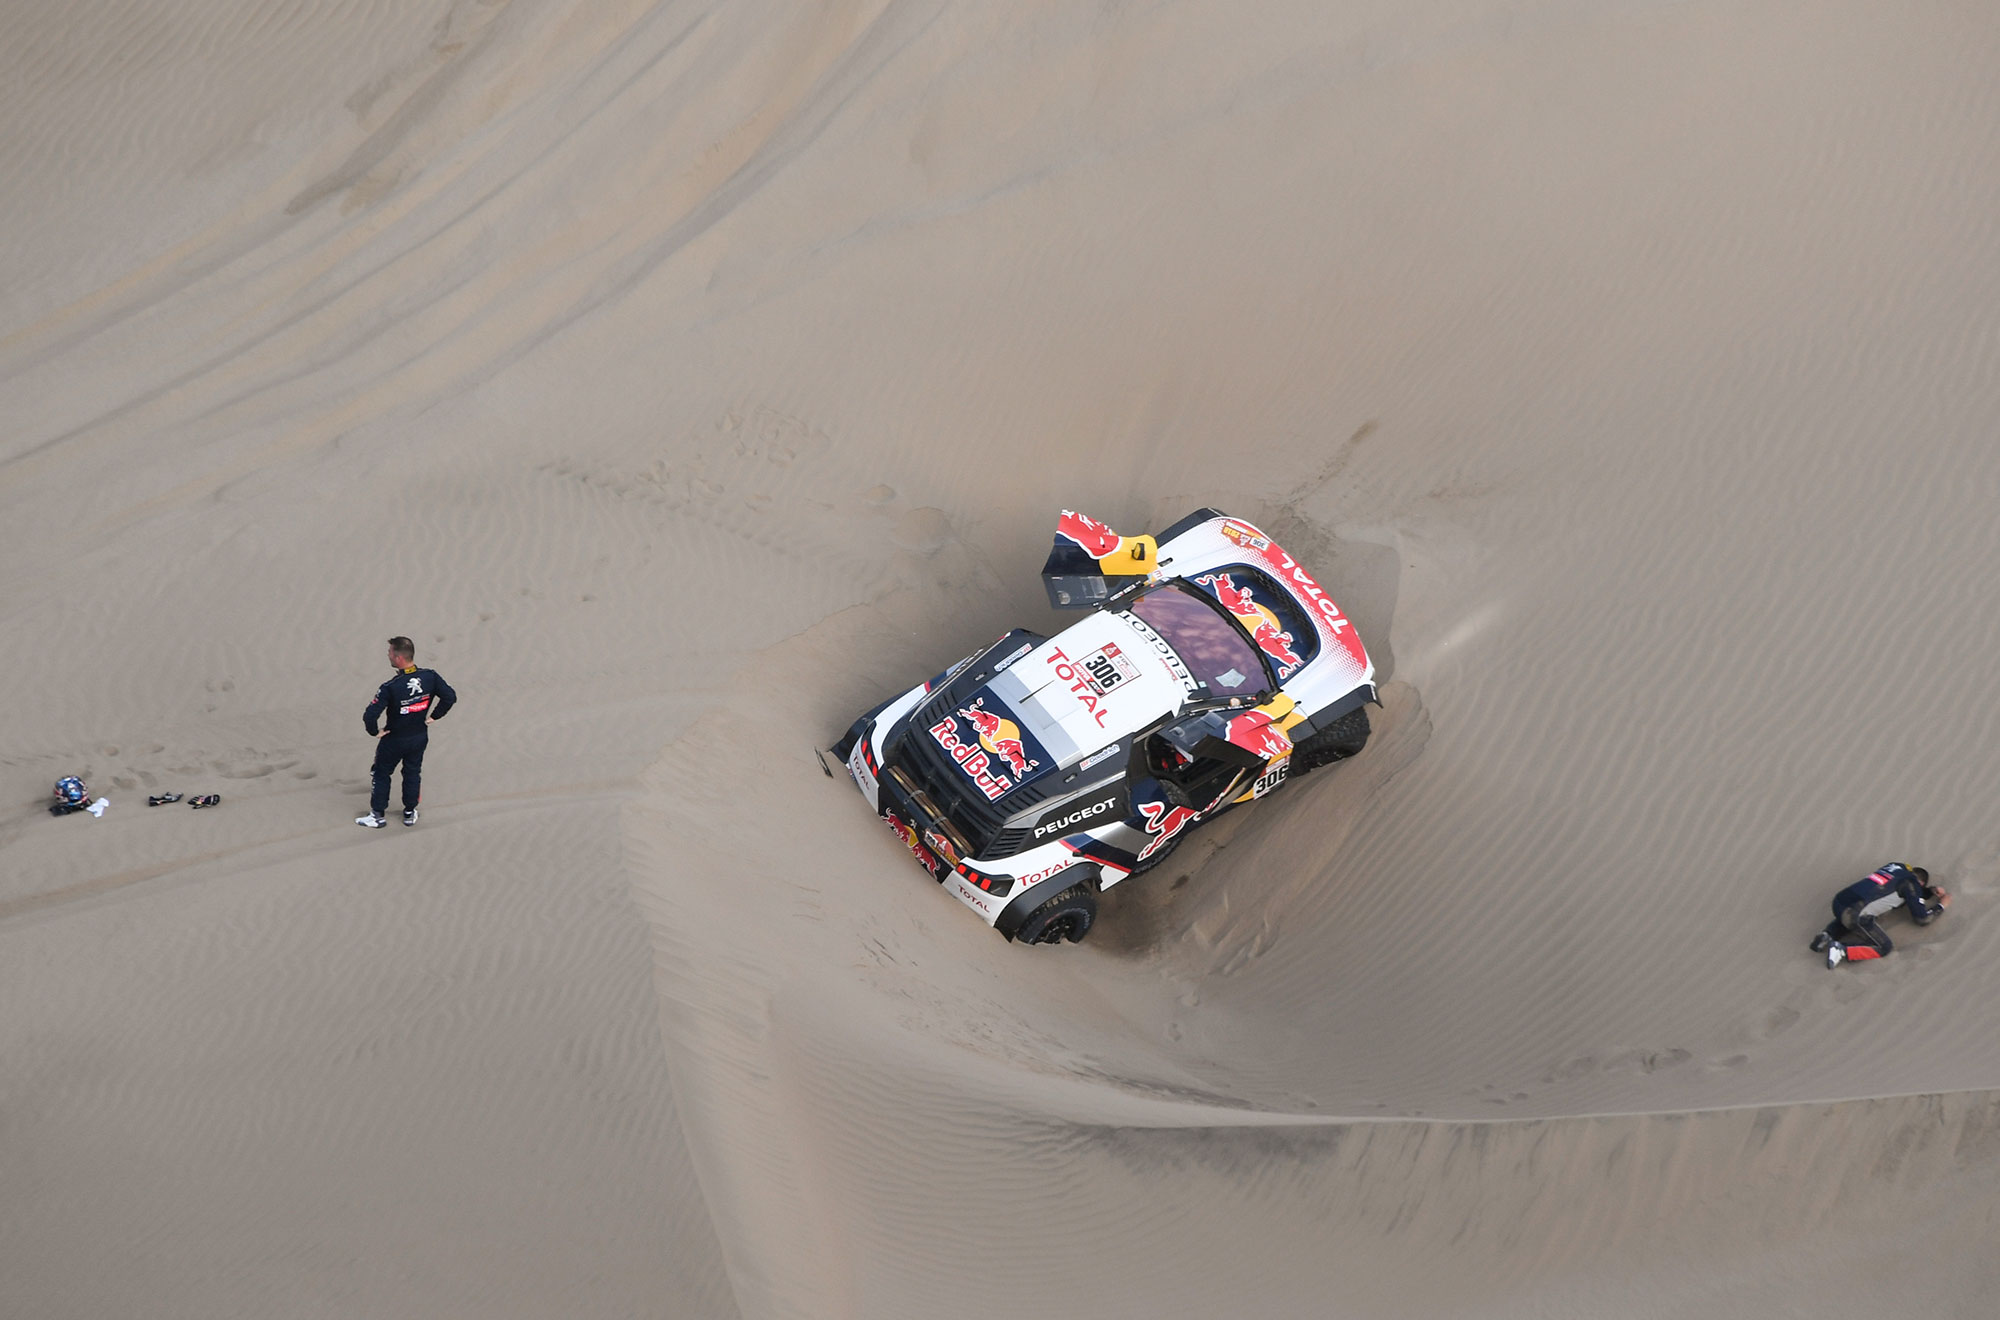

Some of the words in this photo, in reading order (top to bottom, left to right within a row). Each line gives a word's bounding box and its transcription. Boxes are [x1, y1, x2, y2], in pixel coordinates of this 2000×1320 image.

[1252, 538, 1267, 549] 306
[1281, 552, 1348, 635] TOTAL
[1118, 614, 1194, 692] PEUGEOT
[1047, 646, 1108, 729] TOTAL
[1085, 655, 1122, 689] 306
[853, 753, 870, 790] TOTAL
[929, 716, 981, 765] Red
[961, 750, 1013, 801] Bull
[1256, 764, 1288, 794] 306
[1033, 797, 1116, 839] PEUGEOT
[1017, 859, 1074, 887] TOTAL
[958, 884, 990, 914] TOTAL
